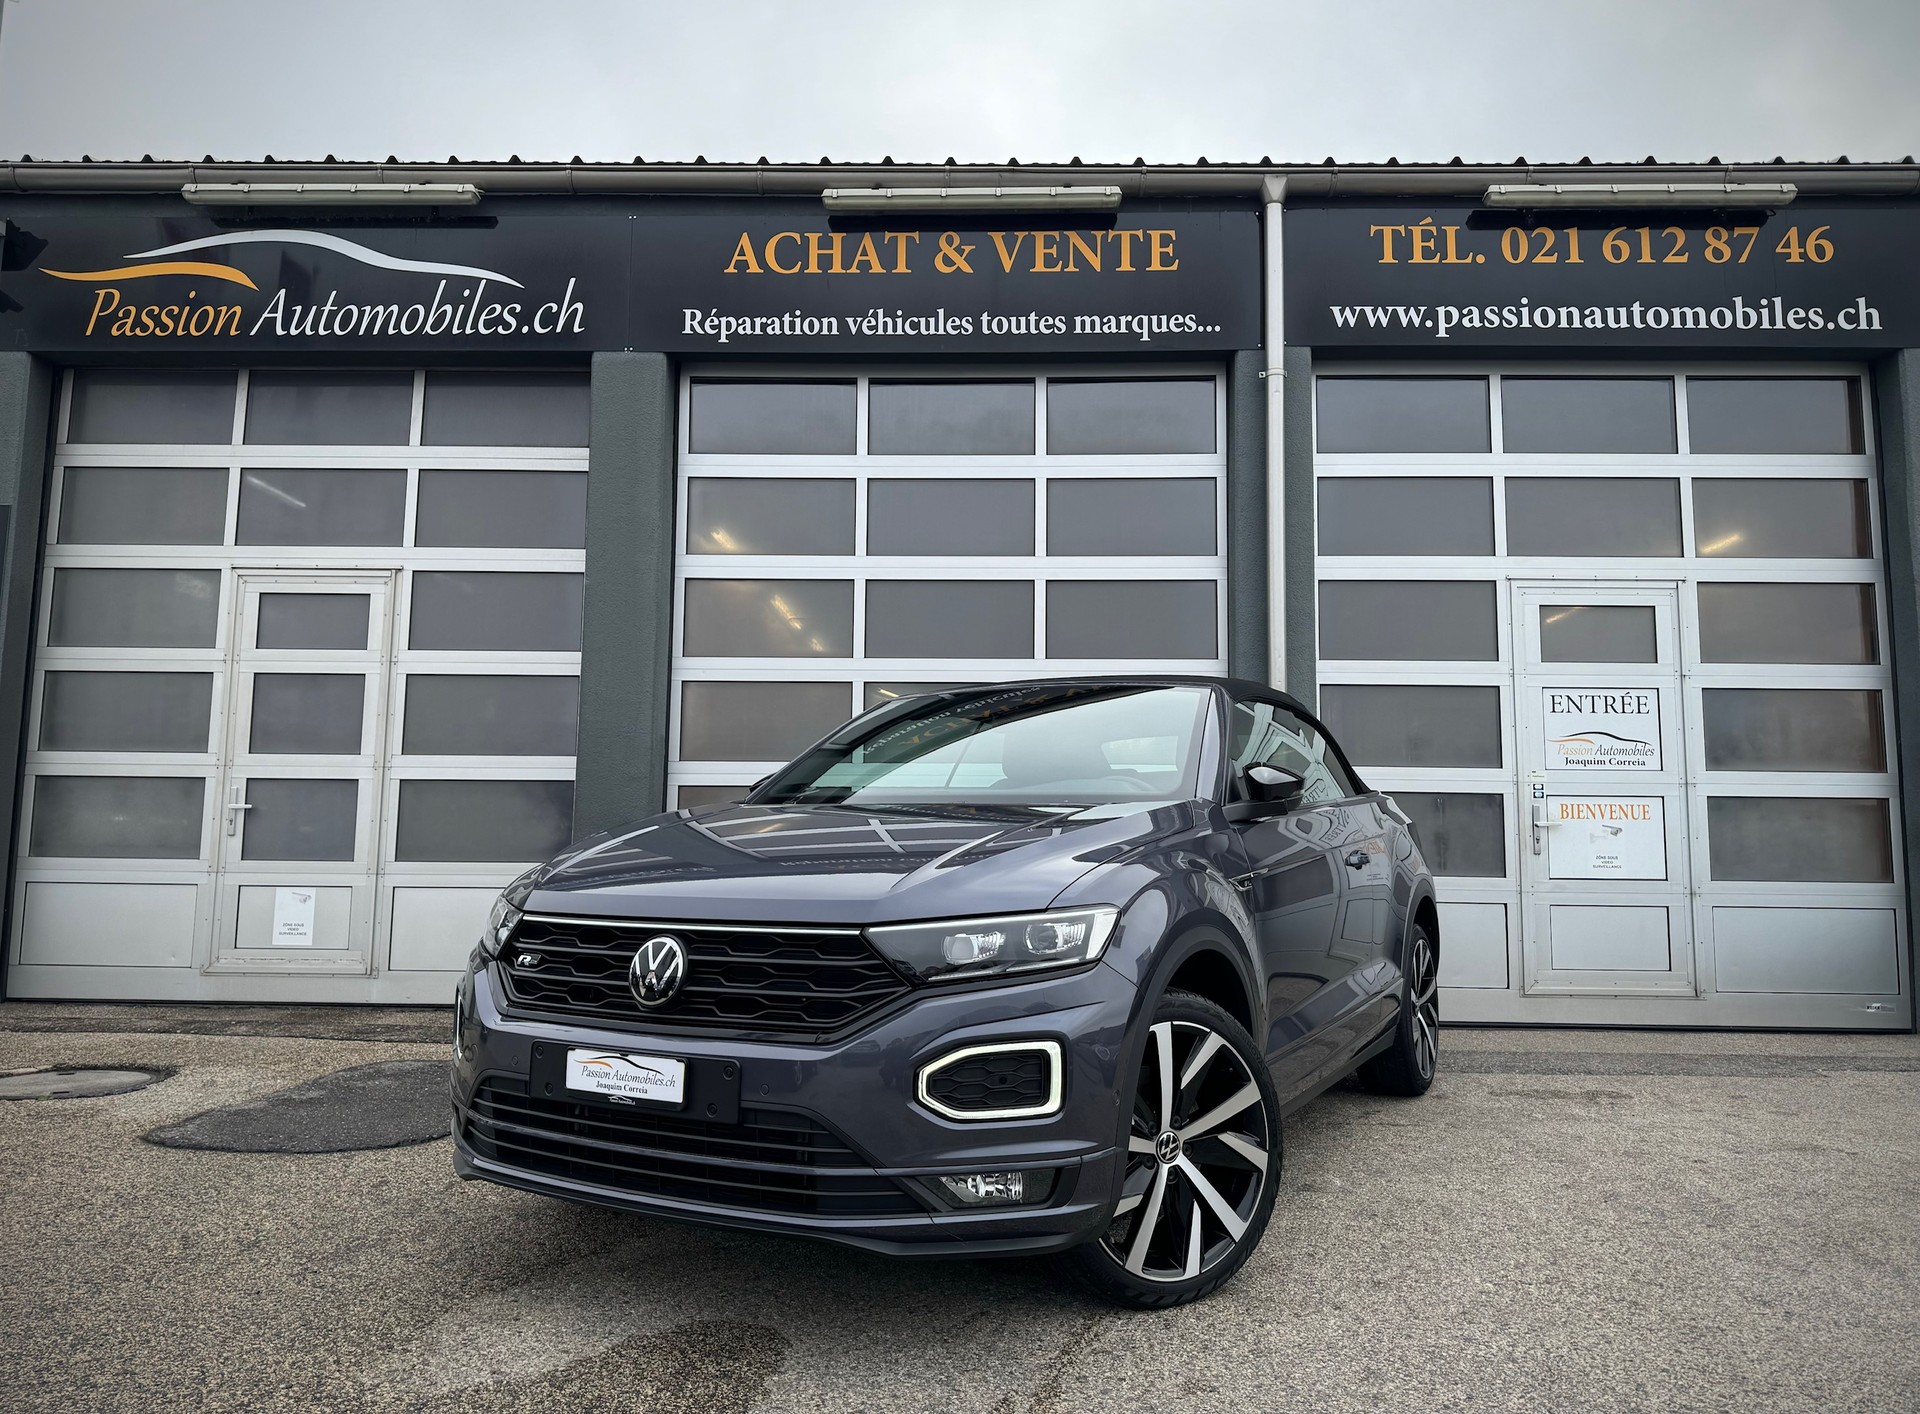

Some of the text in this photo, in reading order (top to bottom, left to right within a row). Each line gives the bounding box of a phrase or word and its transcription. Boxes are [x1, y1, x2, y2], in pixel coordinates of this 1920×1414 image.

[723, 228, 1180, 275] ACHAT & VENTE
[1369, 216, 1835, 264] TÉL. 021 612 87 46
[85, 277, 586, 337] Passion Automobiles.ch
[1329, 295, 1884, 338] www.passionautomobiles.ch
[682, 307, 1222, 343] Réparation véhicules toutes marques...
[1549, 691, 1651, 715] ENTRÉE
[1557, 742, 1656, 757] Passion Automobiles
[1564, 756, 1647, 768] Joaquim Correia
[1559, 802, 1652, 821] BIENVENUE
[581, 1065, 676, 1088] Passion Automobiles.ch
[595, 1080, 648, 1095] Joaquim Correia
